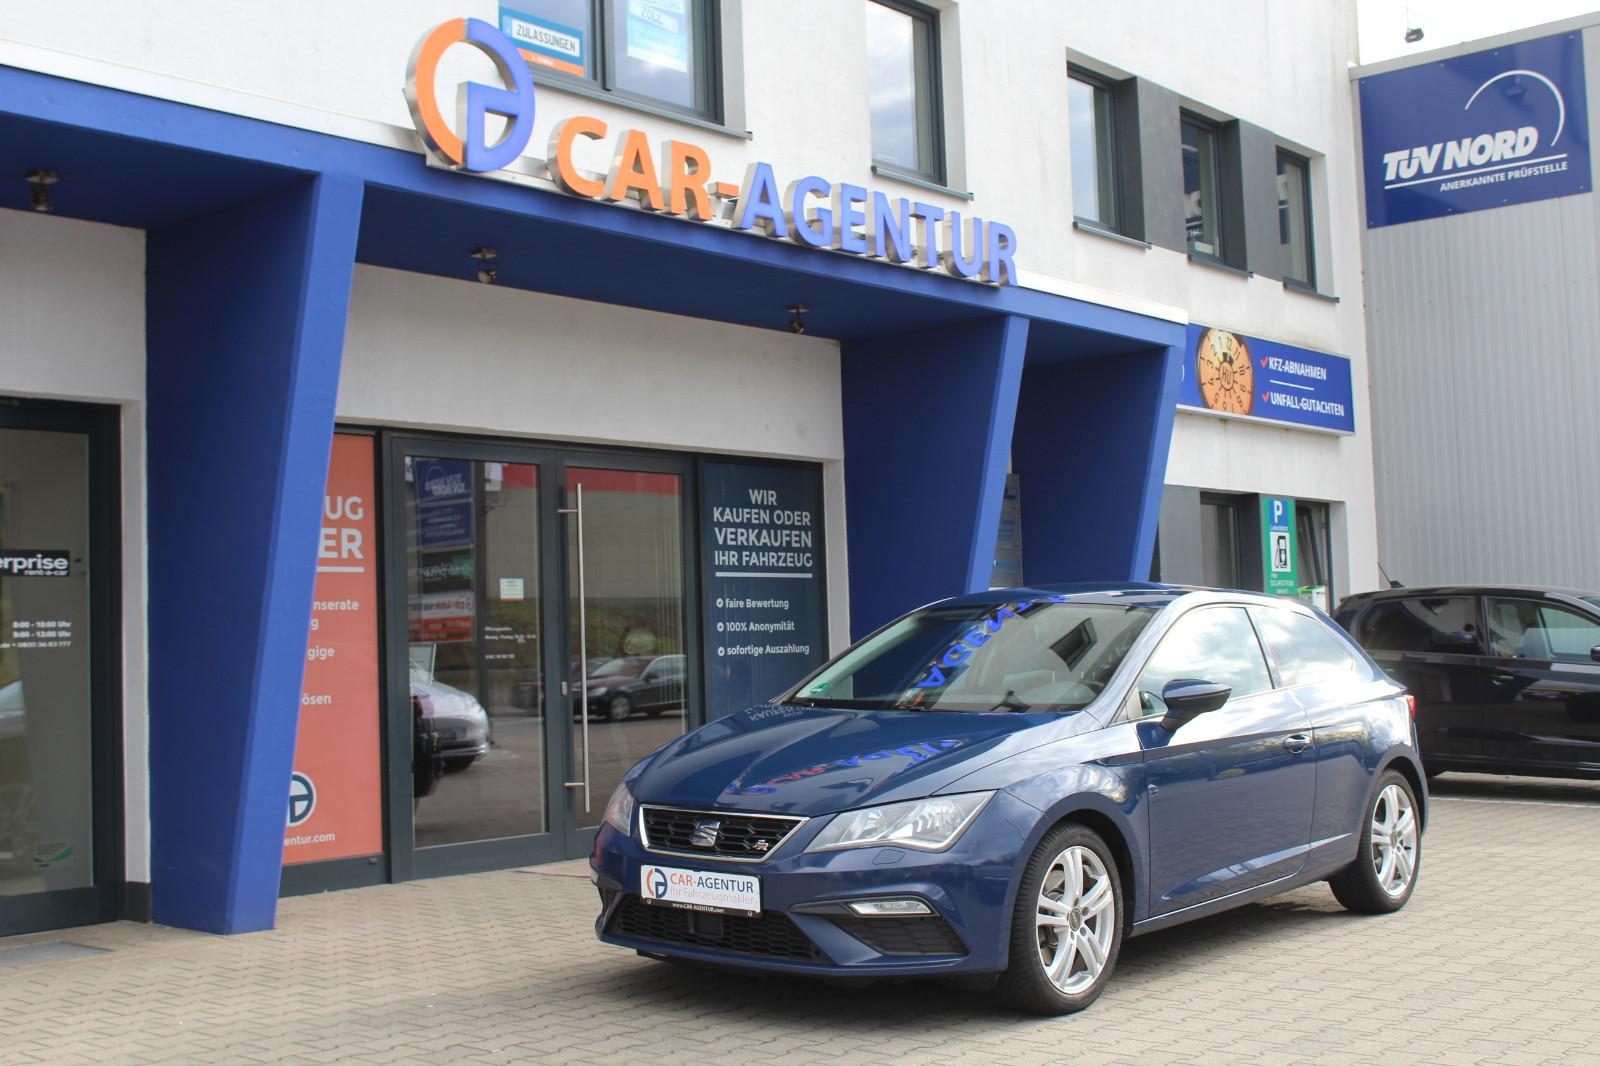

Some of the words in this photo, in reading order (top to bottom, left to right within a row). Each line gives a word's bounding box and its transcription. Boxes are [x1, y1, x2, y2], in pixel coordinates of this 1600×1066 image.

[516, 23, 576, 53] ZULASSUNGEN
[1383, 143, 1443, 182] TÜV
[1442, 126, 1538, 171] NORD
[1440, 171, 1506, 192] ANERKANNTE
[1507, 161, 1568, 181] PRÜFSTELLE
[550, 115, 1018, 286] CAR-AGENTUR
[1222, 367, 1232, 385] HU
[1269, 357, 1327, 380] KFZ-ABNAHMEN
[1271, 392, 1345, 417] UNFALL-GUTACHTEN
[749, 489, 777, 506] WIR
[324, 496, 364, 520] UG
[713, 507, 770, 524] KAUFEN
[773, 511, 811, 526] ODER
[1273, 500, 1283, 523] P
[318, 527, 364, 559] ER
[714, 527, 812, 548] VERKAUFEN
[0, 553, 69, 573] rprise
[714, 551, 739, 566] IHR
[742, 552, 813, 567] FAHRZEUG
[313, 599, 359, 611] nserate
[725, 598, 745, 608] faire
[746, 599, 789, 610] Bewertung
[725, 621, 747, 632] 100%
[749, 621, 795, 633] Anonymität
[307, 646, 335, 660] gige
[727, 645, 764, 656] sofortige
[765, 643, 810, 655] Auszahlung
[302, 694, 332, 705] ösen
[670, 873, 754, 893] CAR-AGENTUR
[670, 886, 683, 897] Ihr
[684, 888, 755, 905] Fahrzeugmakler
